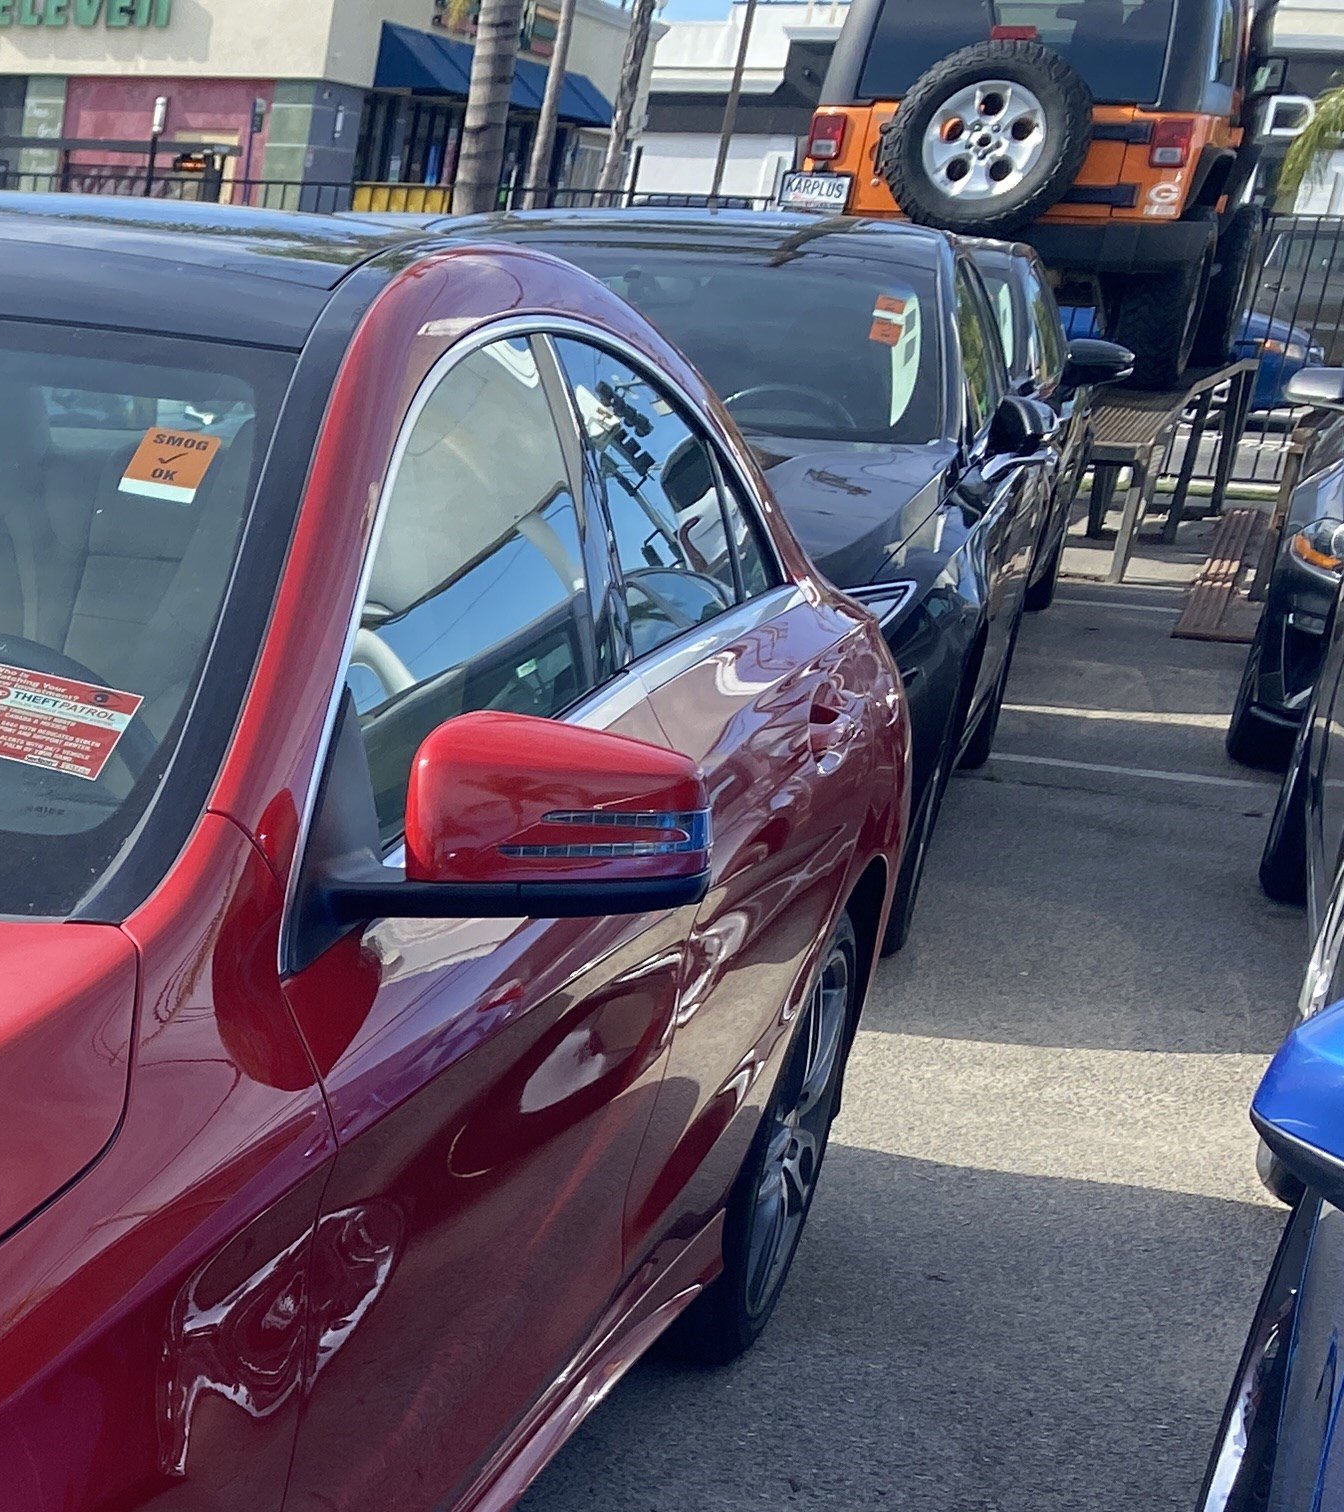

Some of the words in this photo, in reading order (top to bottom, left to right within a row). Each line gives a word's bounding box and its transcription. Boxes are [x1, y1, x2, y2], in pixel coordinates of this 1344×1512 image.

[785, 176, 844, 199] KARPLUS
[152, 433, 209, 451] SMOG
[150, 467, 178, 481] OK
[13, 682, 79, 701] Investment?
[41, 683, 67, 693] Your
